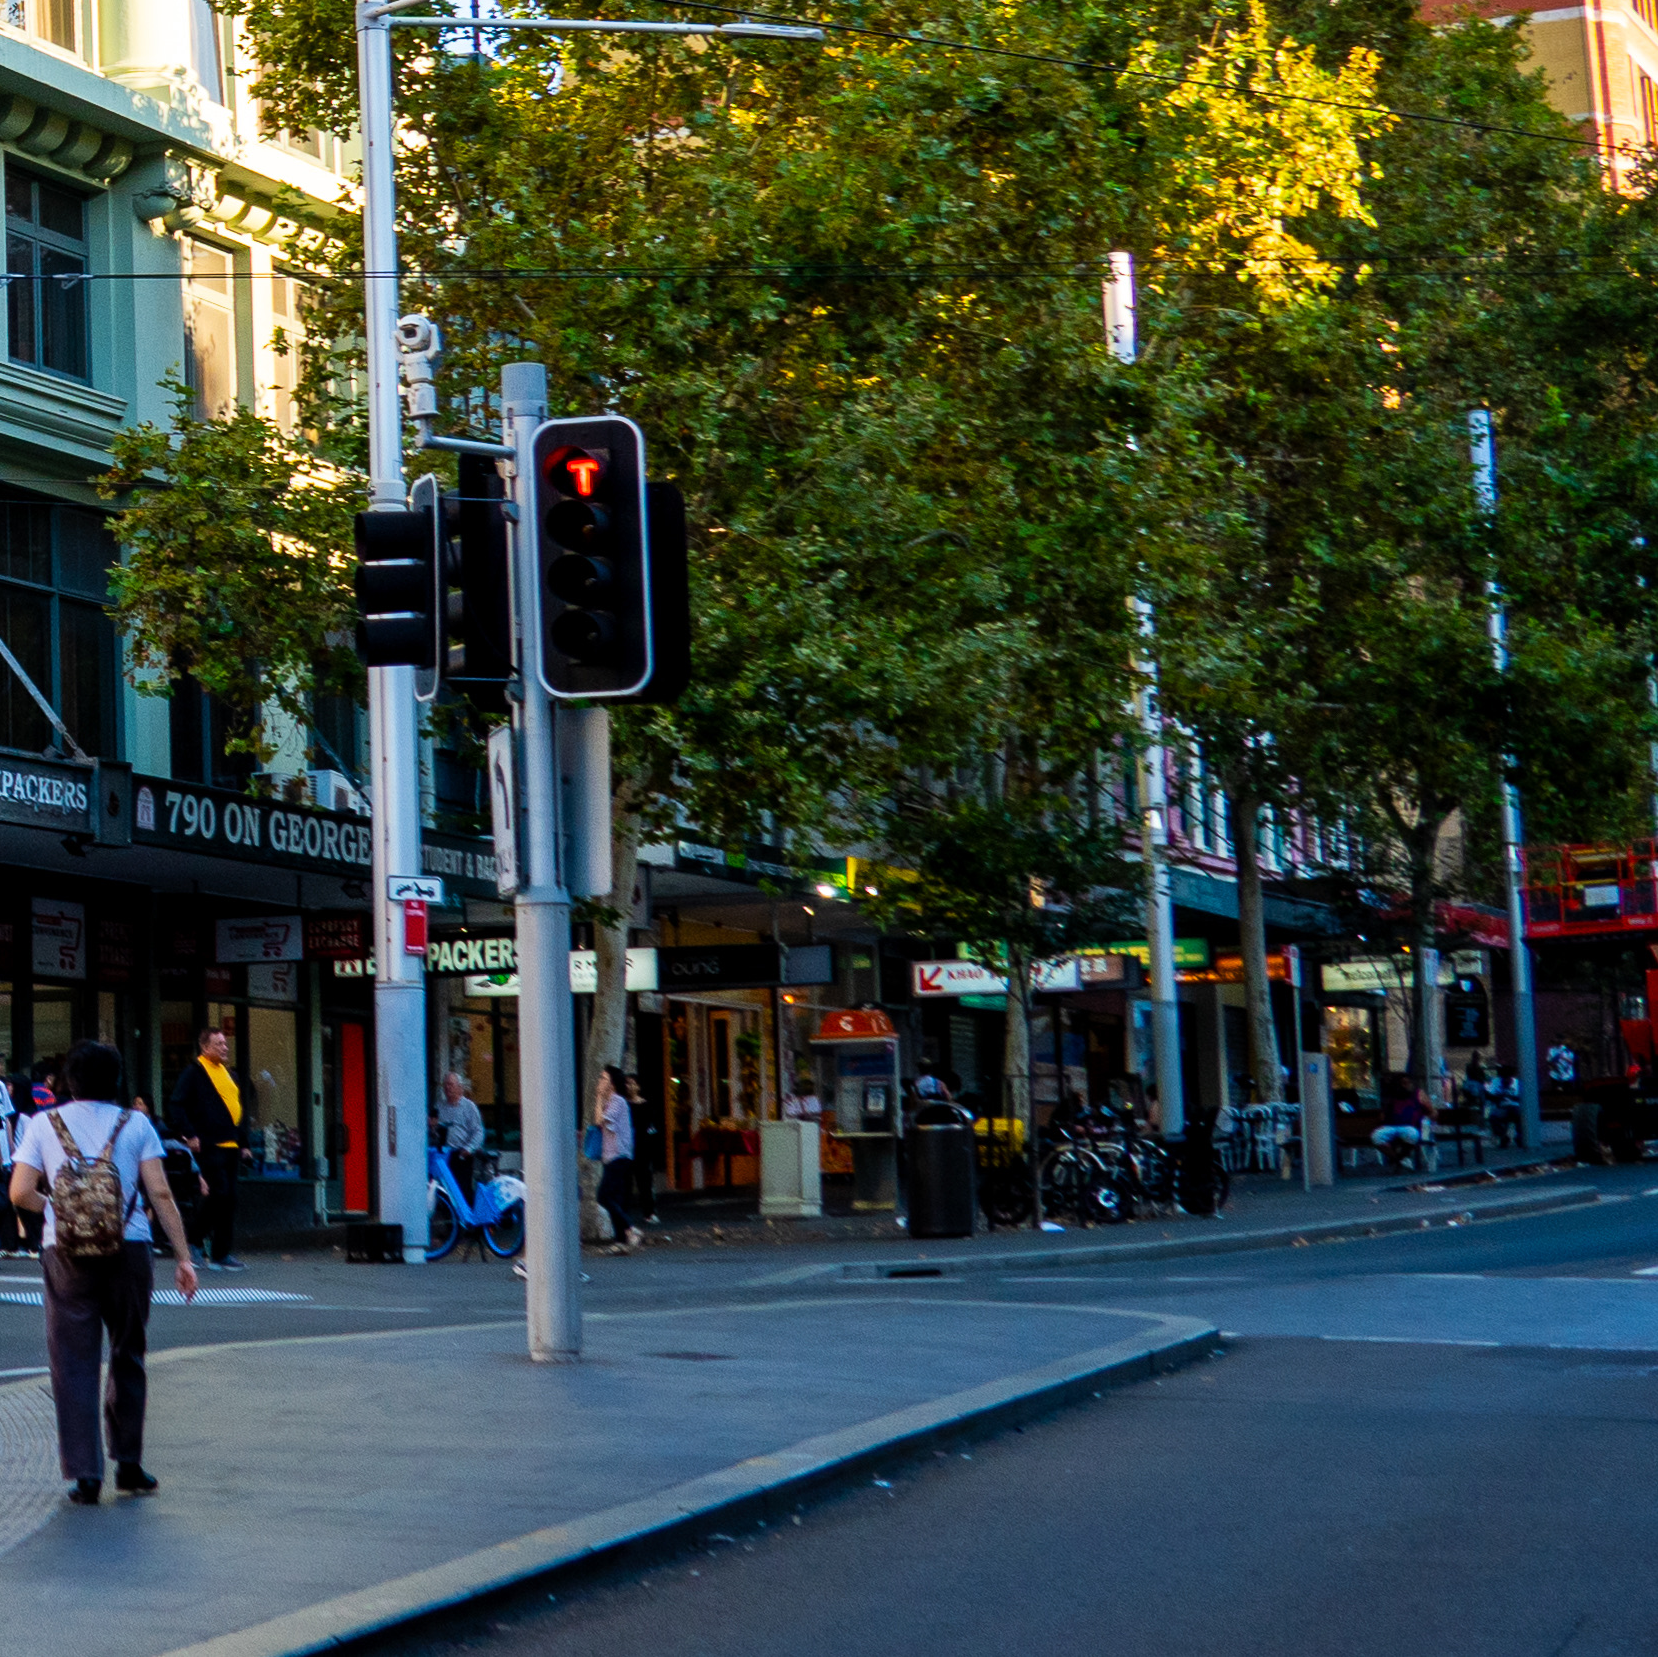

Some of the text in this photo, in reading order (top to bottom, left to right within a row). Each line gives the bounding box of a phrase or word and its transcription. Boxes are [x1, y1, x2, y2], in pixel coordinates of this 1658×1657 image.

[165, 791, 373, 866] 790 ON GEORGE
[423, 844, 463, 875] TUDENT
